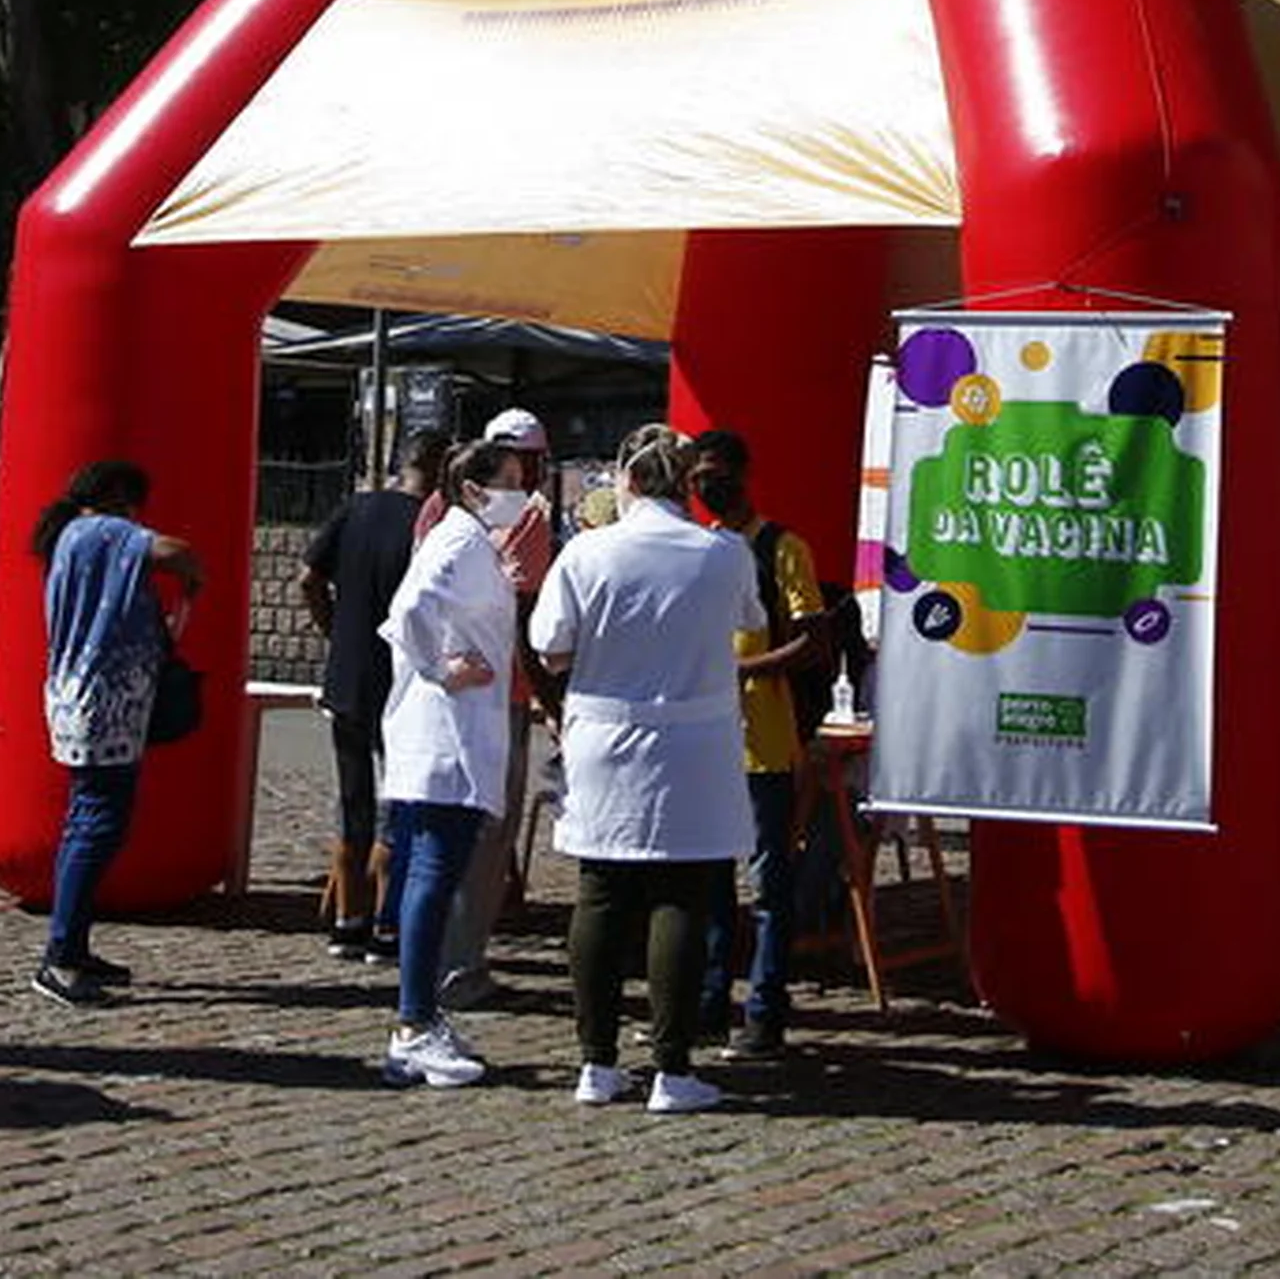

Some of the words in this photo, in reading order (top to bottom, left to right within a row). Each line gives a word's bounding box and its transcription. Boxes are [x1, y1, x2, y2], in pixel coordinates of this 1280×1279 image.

[965, 440, 1113, 509] ROLÊ
[932, 507, 981, 544] DA
[988, 510, 1168, 564] VACINA
